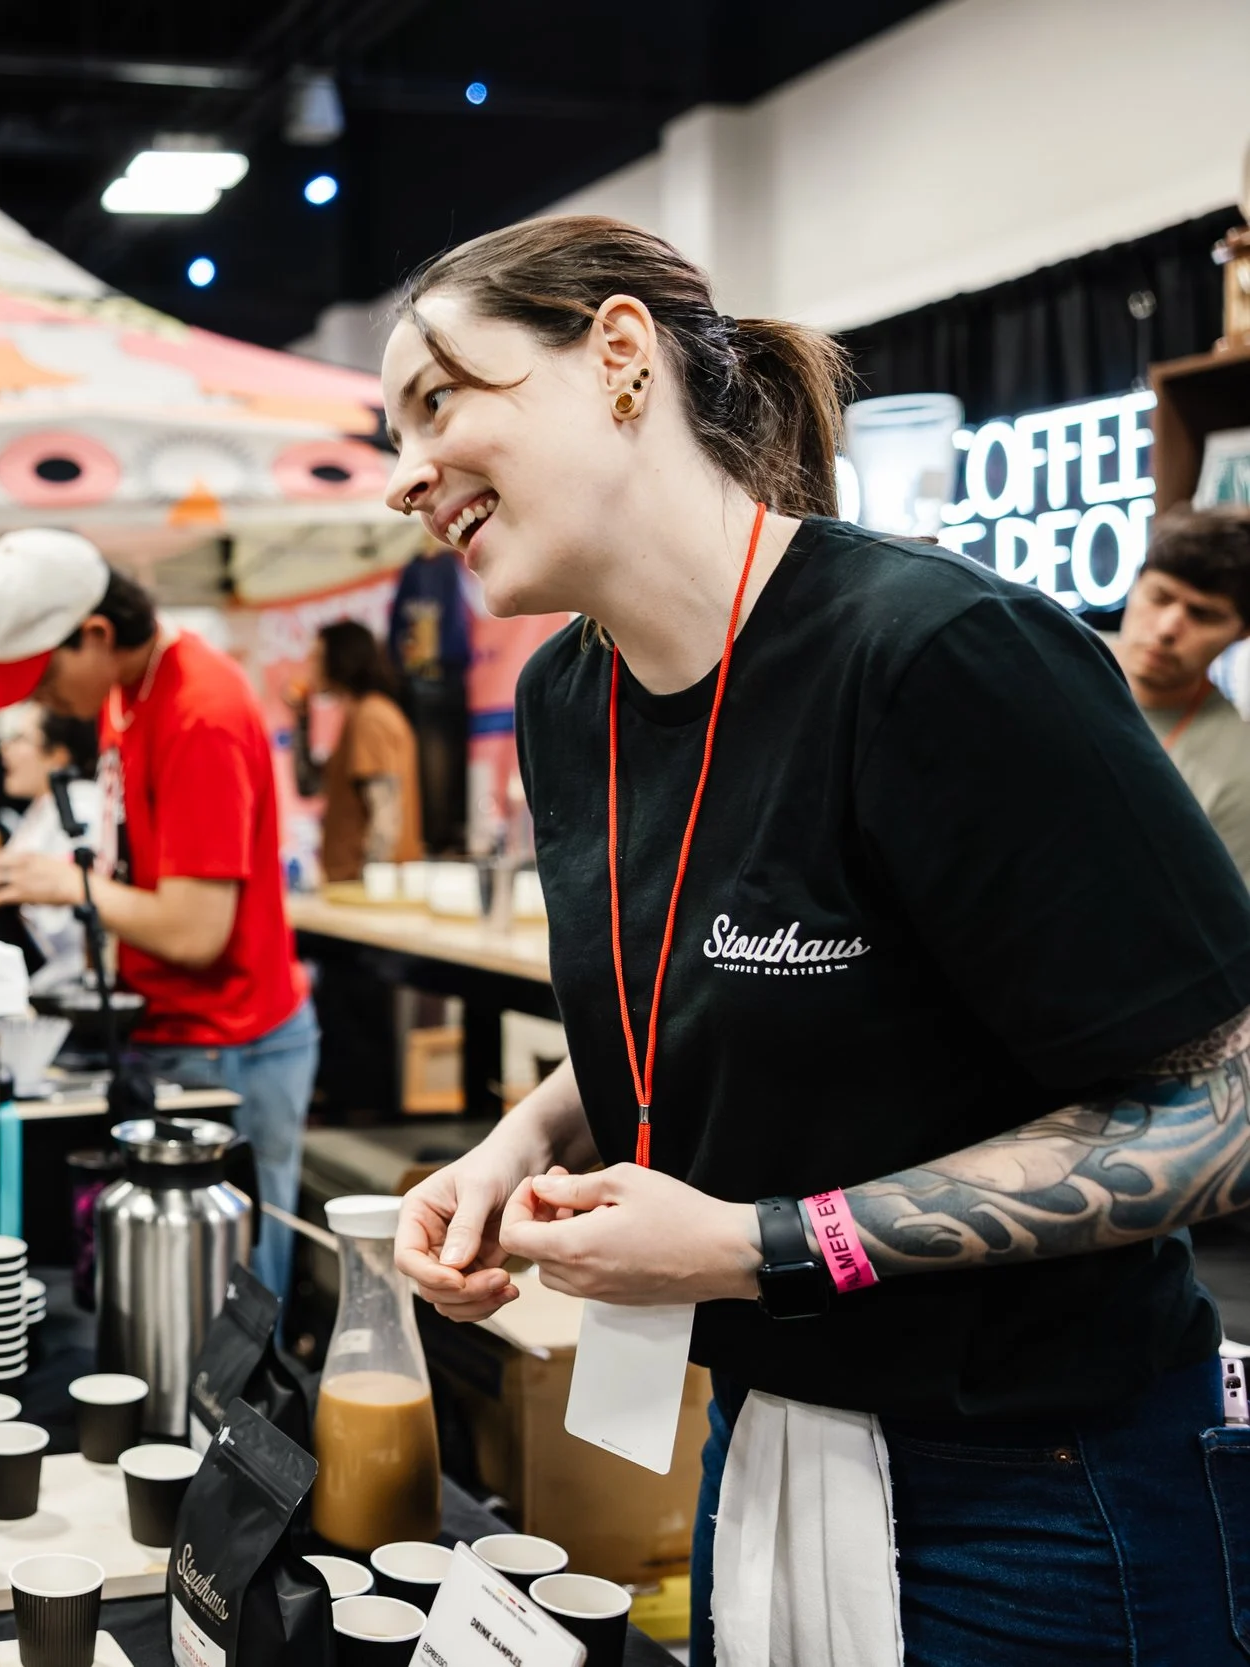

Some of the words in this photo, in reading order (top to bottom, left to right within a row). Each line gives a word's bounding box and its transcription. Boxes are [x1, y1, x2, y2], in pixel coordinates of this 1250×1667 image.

[703, 913, 871, 964] Stouthaus
[723, 963, 759, 974] COFFEE
[764, 964, 832, 975] ROASTERS
[176, 1543, 229, 1621] Stouthaus
[470, 1617, 493, 1643] DRINK
[492, 1637, 523, 1667] SAMPLES
